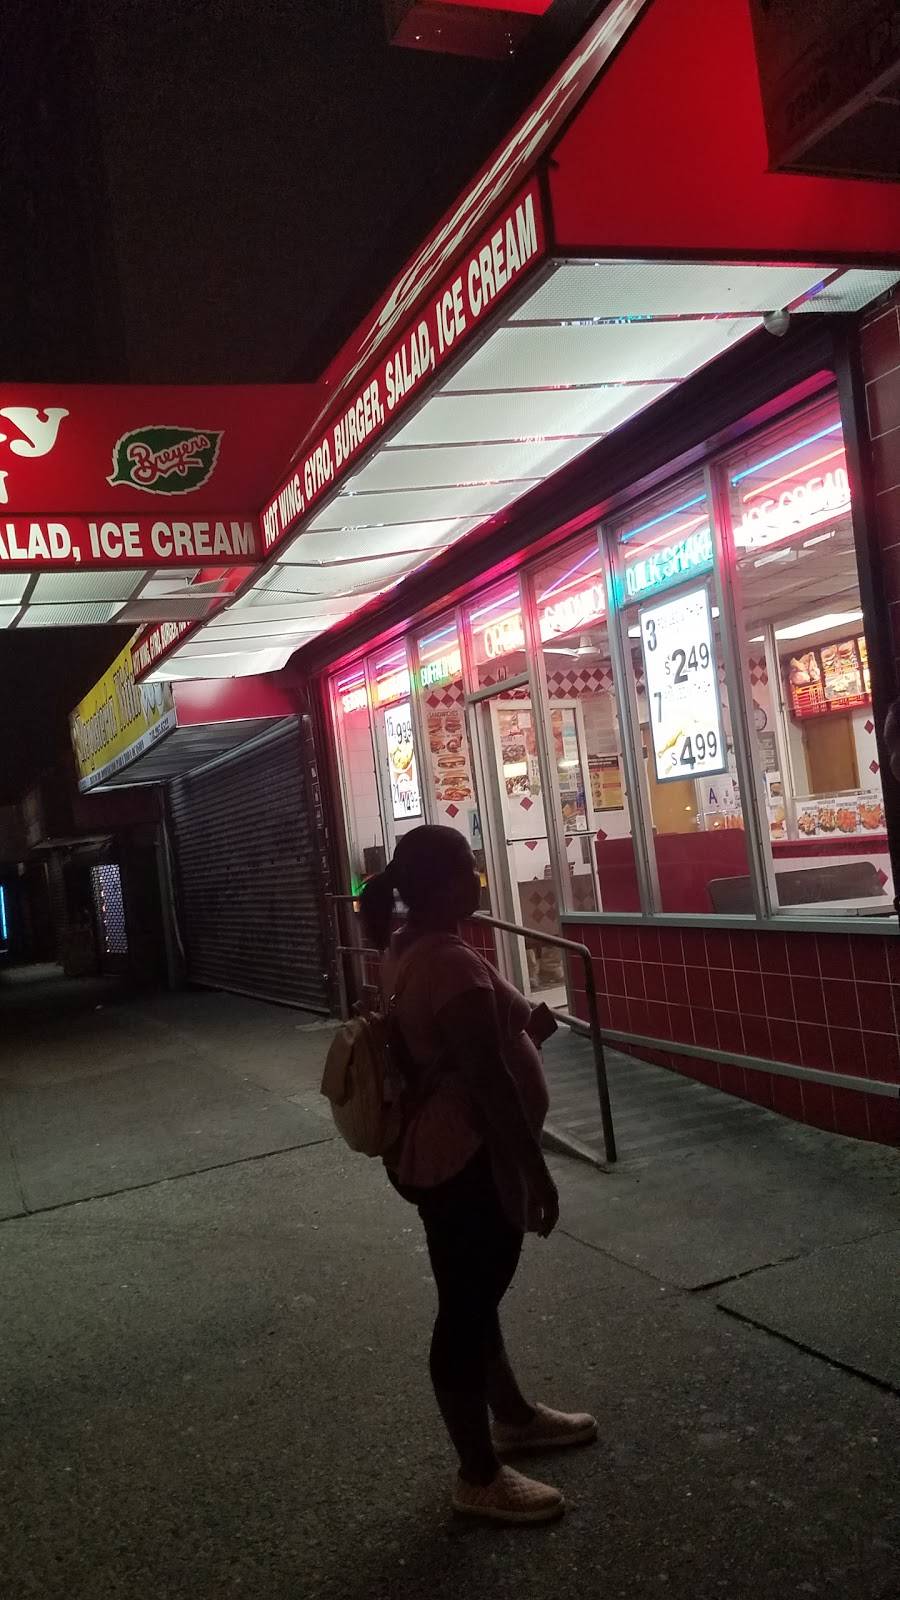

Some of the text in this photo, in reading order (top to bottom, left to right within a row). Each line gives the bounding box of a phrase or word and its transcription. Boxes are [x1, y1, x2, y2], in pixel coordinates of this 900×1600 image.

[263, 501, 279, 549] HOT
[279, 473, 305, 530] WING,
[304, 438, 335, 502] GYRO,
[334, 379, 385, 467] BURGER,
[385, 321, 435, 410] SALAD,
[436, 276, 467, 354] ICE
[468, 193, 538, 318] CREAM
[127, 434, 210, 485] Breyers
[88, 522, 144, 559] ICE
[151, 521, 256, 557] CREAM
[646, 619, 658, 652] 3
[709, 787, 718, 805] A
